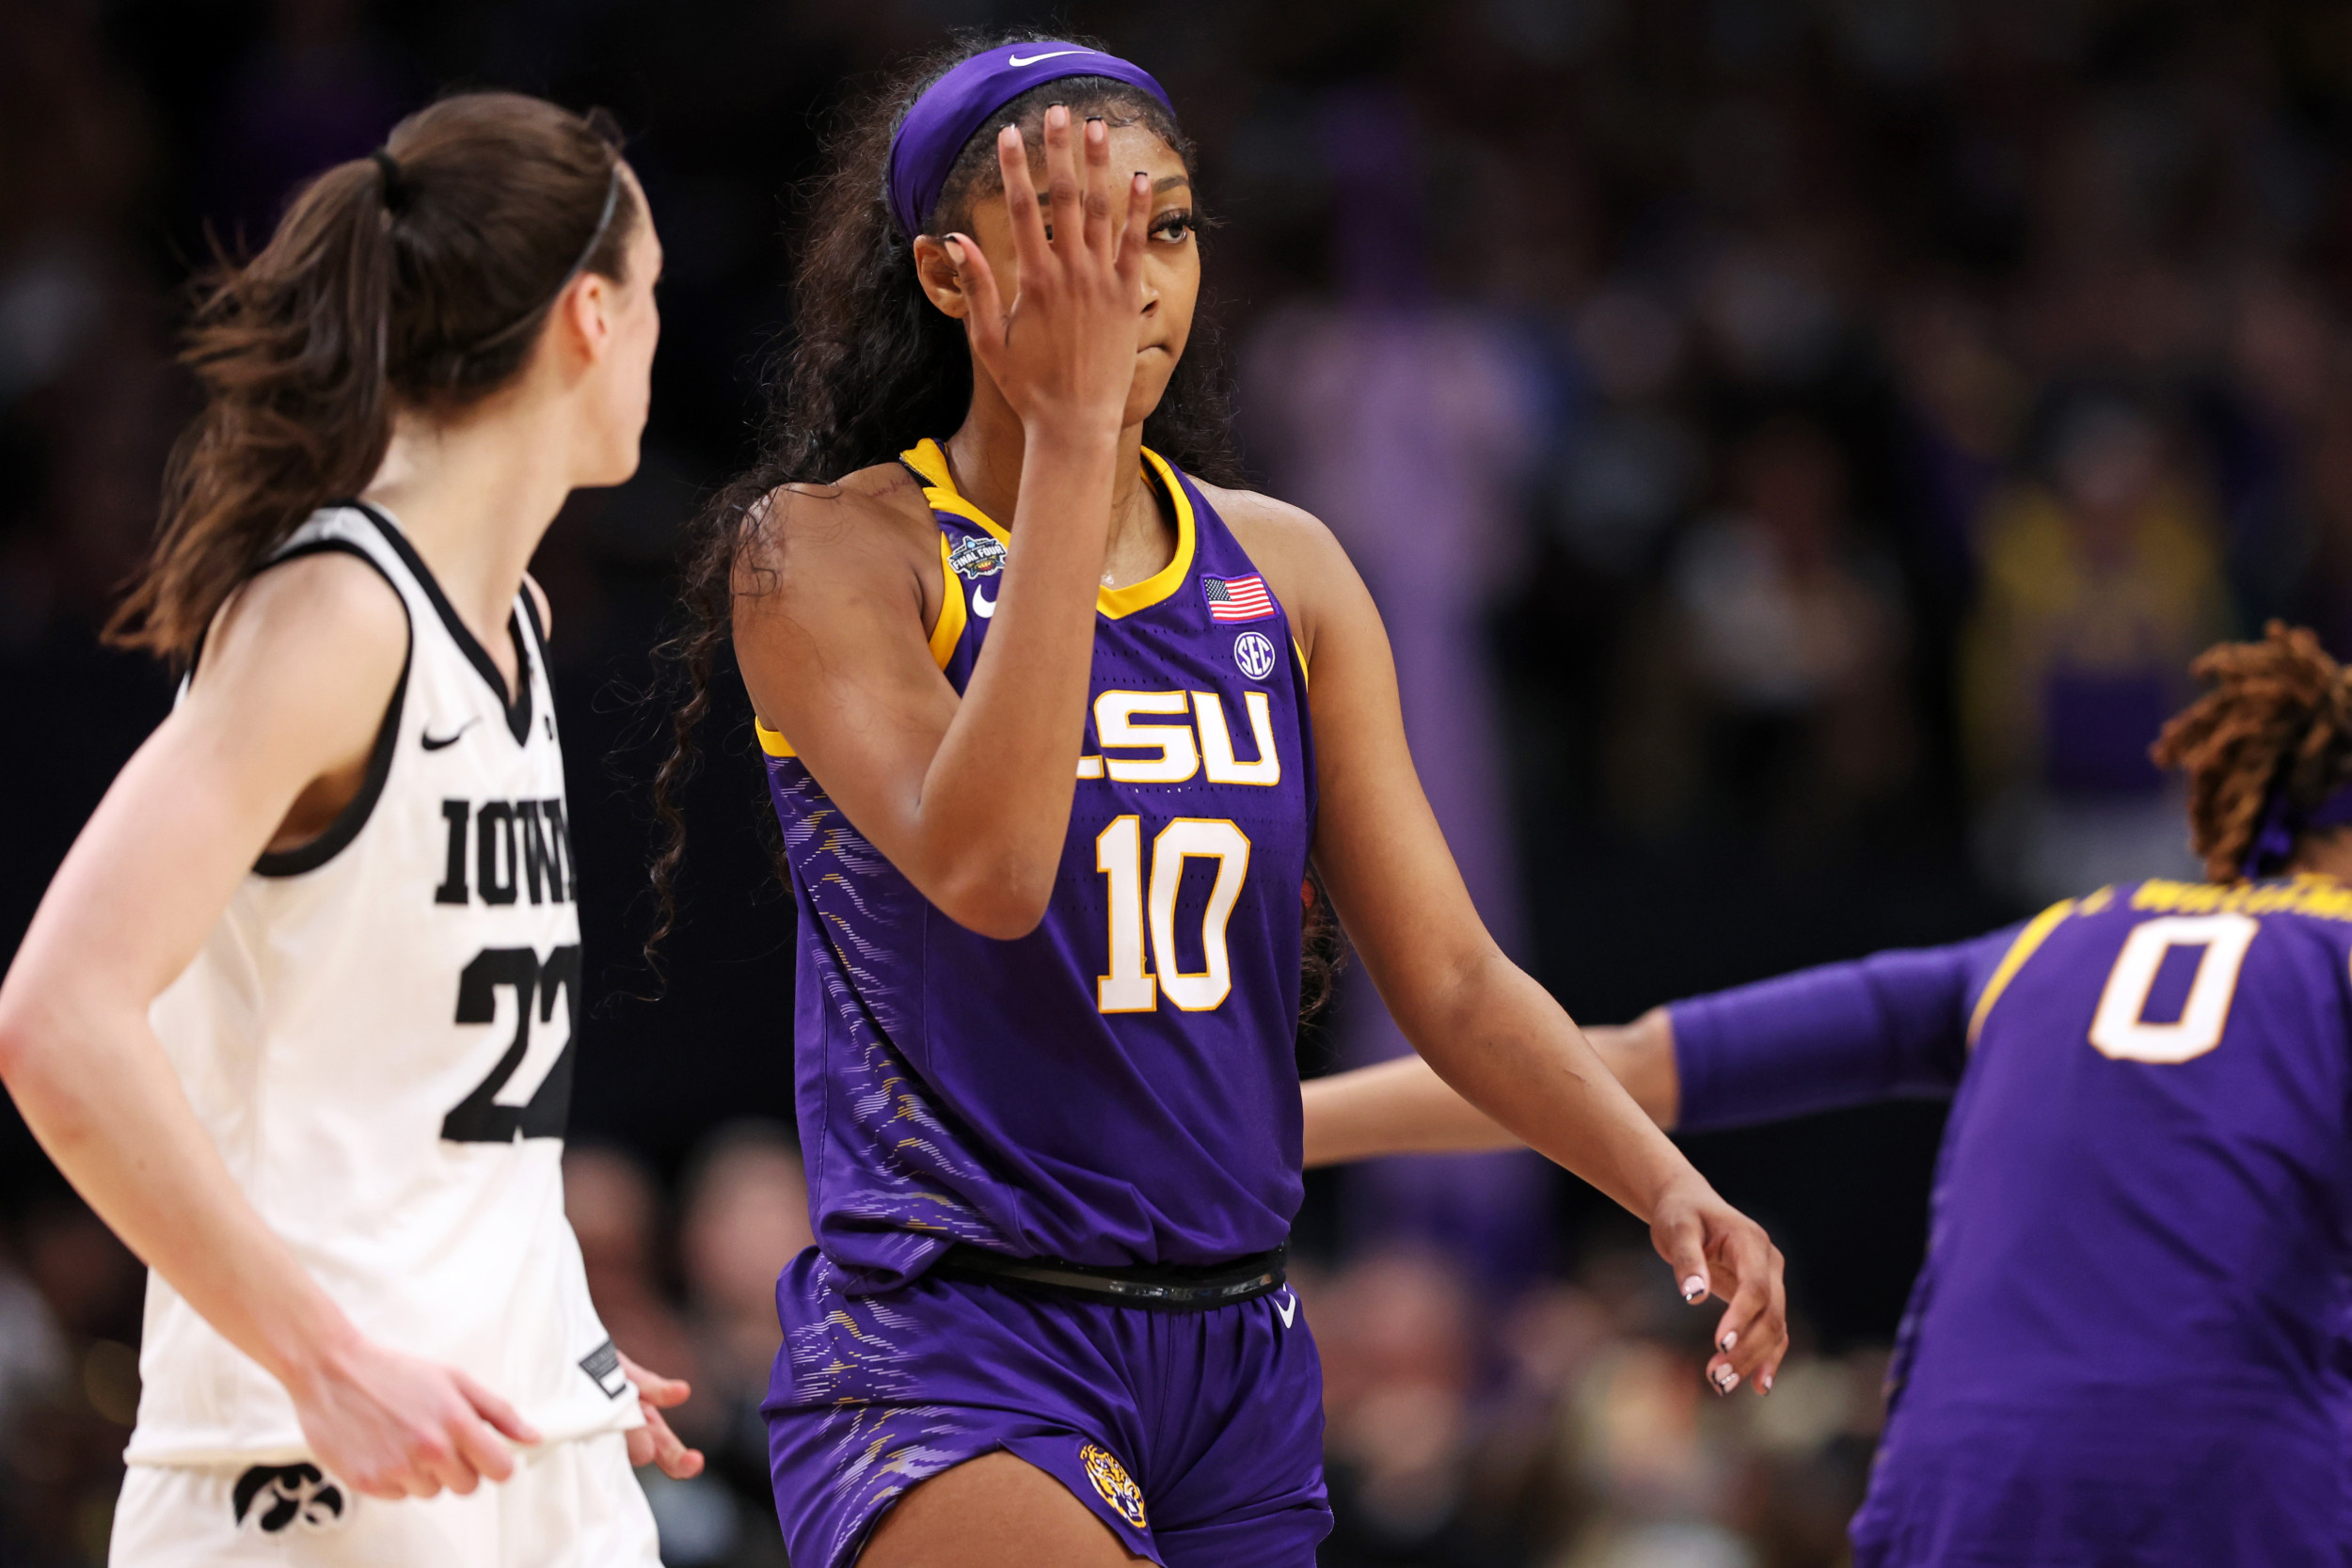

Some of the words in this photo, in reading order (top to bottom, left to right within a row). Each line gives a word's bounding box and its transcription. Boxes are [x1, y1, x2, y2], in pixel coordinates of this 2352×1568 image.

[952, 551, 978, 570] FINAL
[977, 545, 1004, 558] FOUR
[1237, 635, 1272, 675] SEC
[1076, 689, 1280, 786] SU
[435, 797, 578, 906] IOW
[1096, 815, 1251, 1014] 10
[2088, 912, 2260, 1065] 0
[439, 943, 581, 1145] 22
